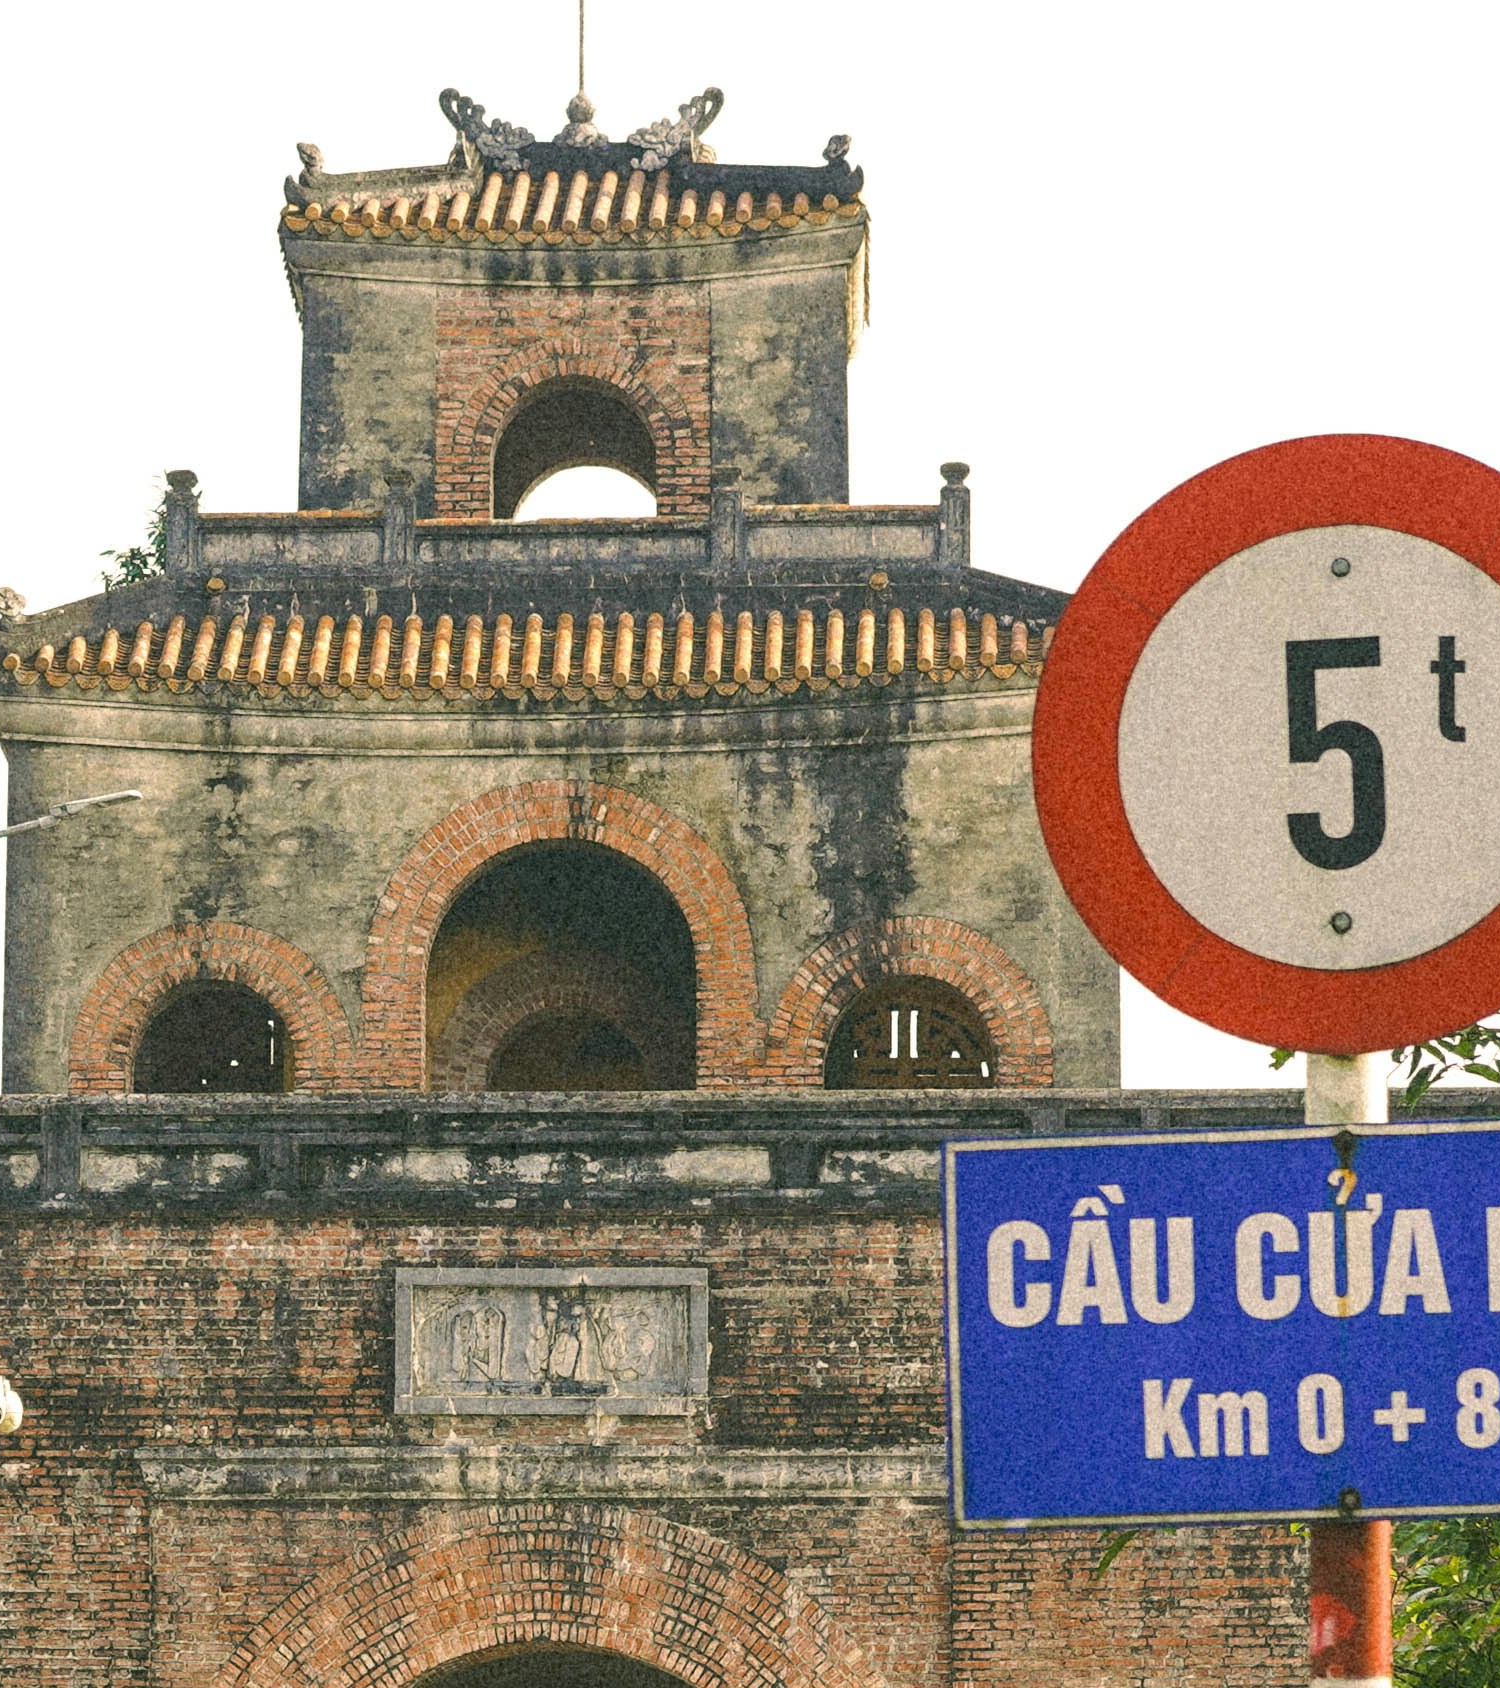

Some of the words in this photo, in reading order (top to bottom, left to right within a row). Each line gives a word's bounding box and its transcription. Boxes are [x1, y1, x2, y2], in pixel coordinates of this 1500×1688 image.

[986, 1183, 1195, 1328] CẦU
[1235, 1168, 1452, 1321] CỬA
[1142, 1376, 1270, 1460] Km
[1297, 1373, 1345, 1455] 0
[1373, 1387, 1427, 1442] +
